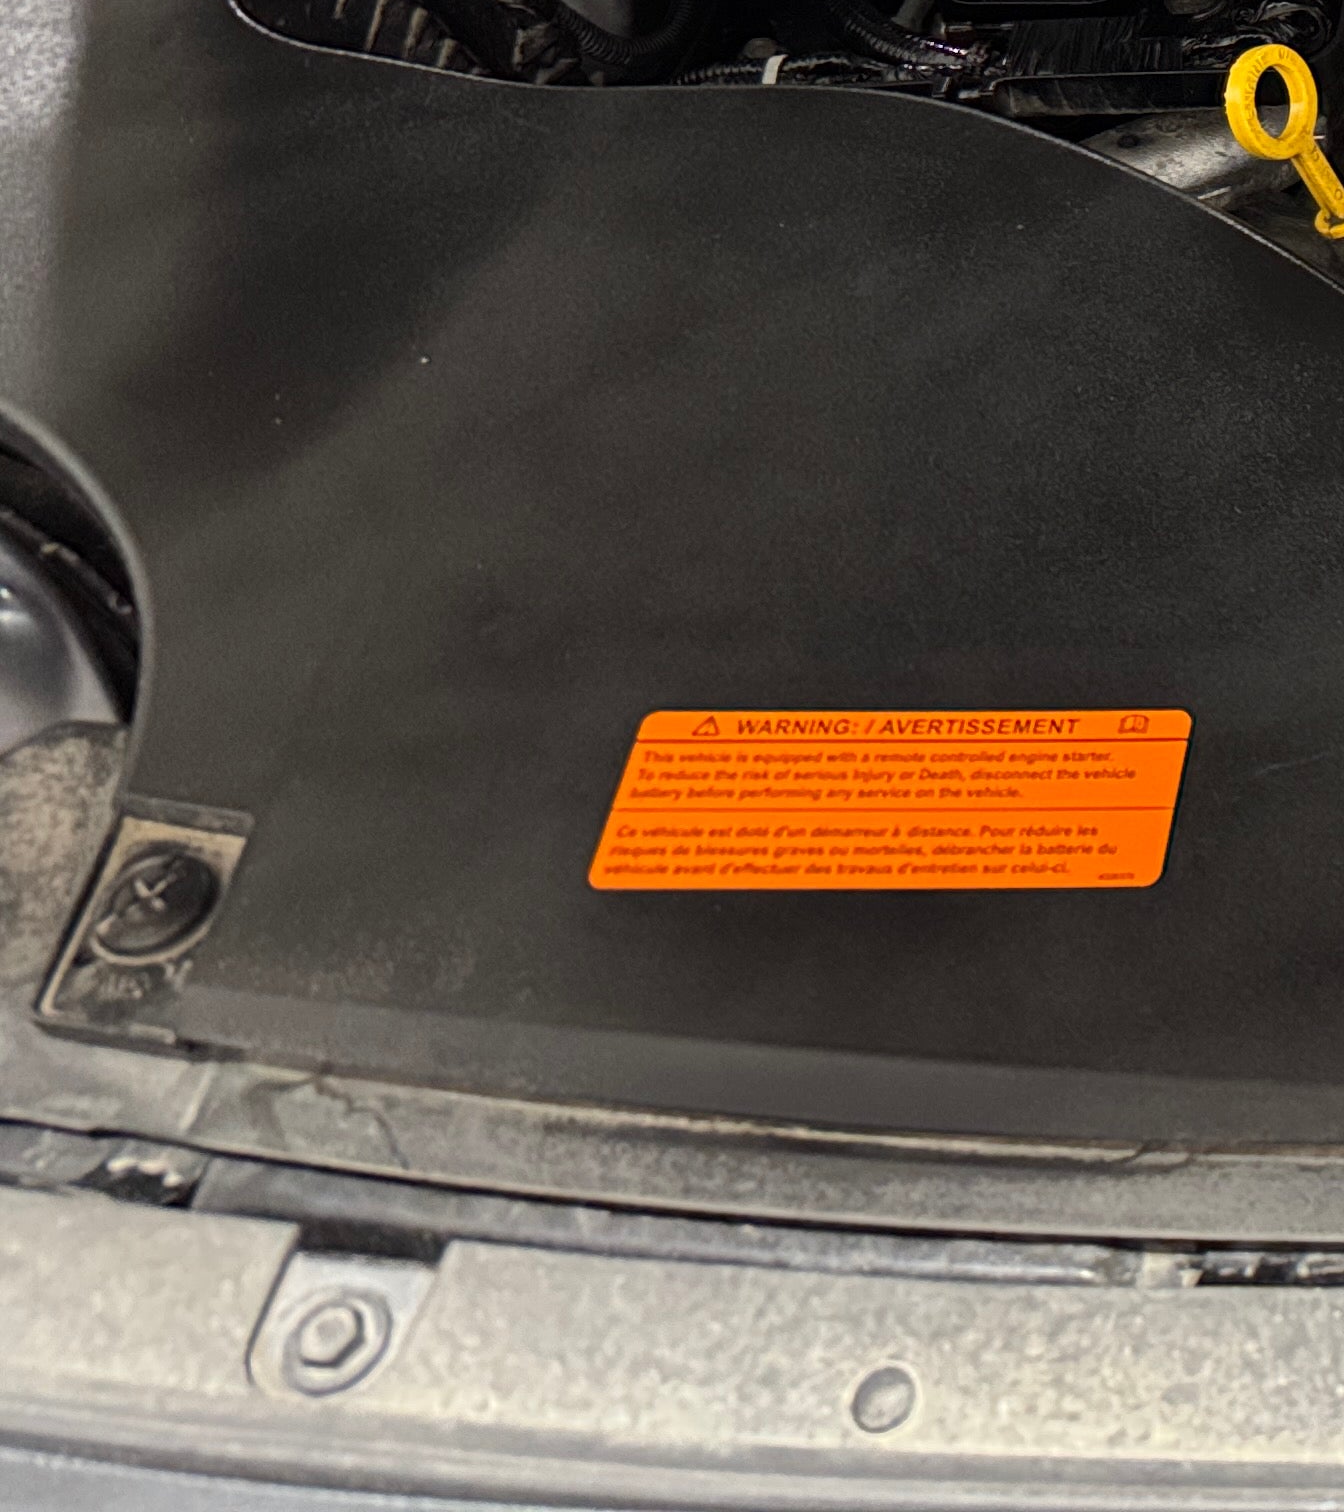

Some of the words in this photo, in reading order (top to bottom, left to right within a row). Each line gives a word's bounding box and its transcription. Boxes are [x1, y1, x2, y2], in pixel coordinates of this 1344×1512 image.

[737, 719, 859, 735] WARNING:
[880, 718, 1080, 735] AVERTISSEMENT
[644, 751, 674, 762] This
[679, 751, 732, 762] vehicle
[753, 751, 823, 764] equipped
[827, 751, 857, 762] with
[874, 752, 925, 762] remote
[930, 751, 1005, 762] controlled
[1009, 752, 1058, 765] engine
[638, 769, 655, 780] To
[659, 769, 710, 780] reduce
[714, 769, 737, 780] the
[742, 769, 768, 780] risk
[774, 769, 791, 780] of
[899, 770, 914, 780] or
[970, 768, 1053, 780] disconnect
[1057, 768, 1080, 780] the
[1084, 768, 1136, 779] vehicle
[687, 787, 735, 798] before
[738, 787, 822, 802] performing
[826, 789, 852, 801] any
[858, 788, 911, 798] service
[915, 789, 935, 798] on
[938, 787, 962, 798] the
[979, 825, 1016, 837] Pour
[1077, 825, 1098, 836] les
[1019, 844, 1033, 855] la
[1036, 844, 1093, 855] batterie
[1097, 844, 1118, 855] du
